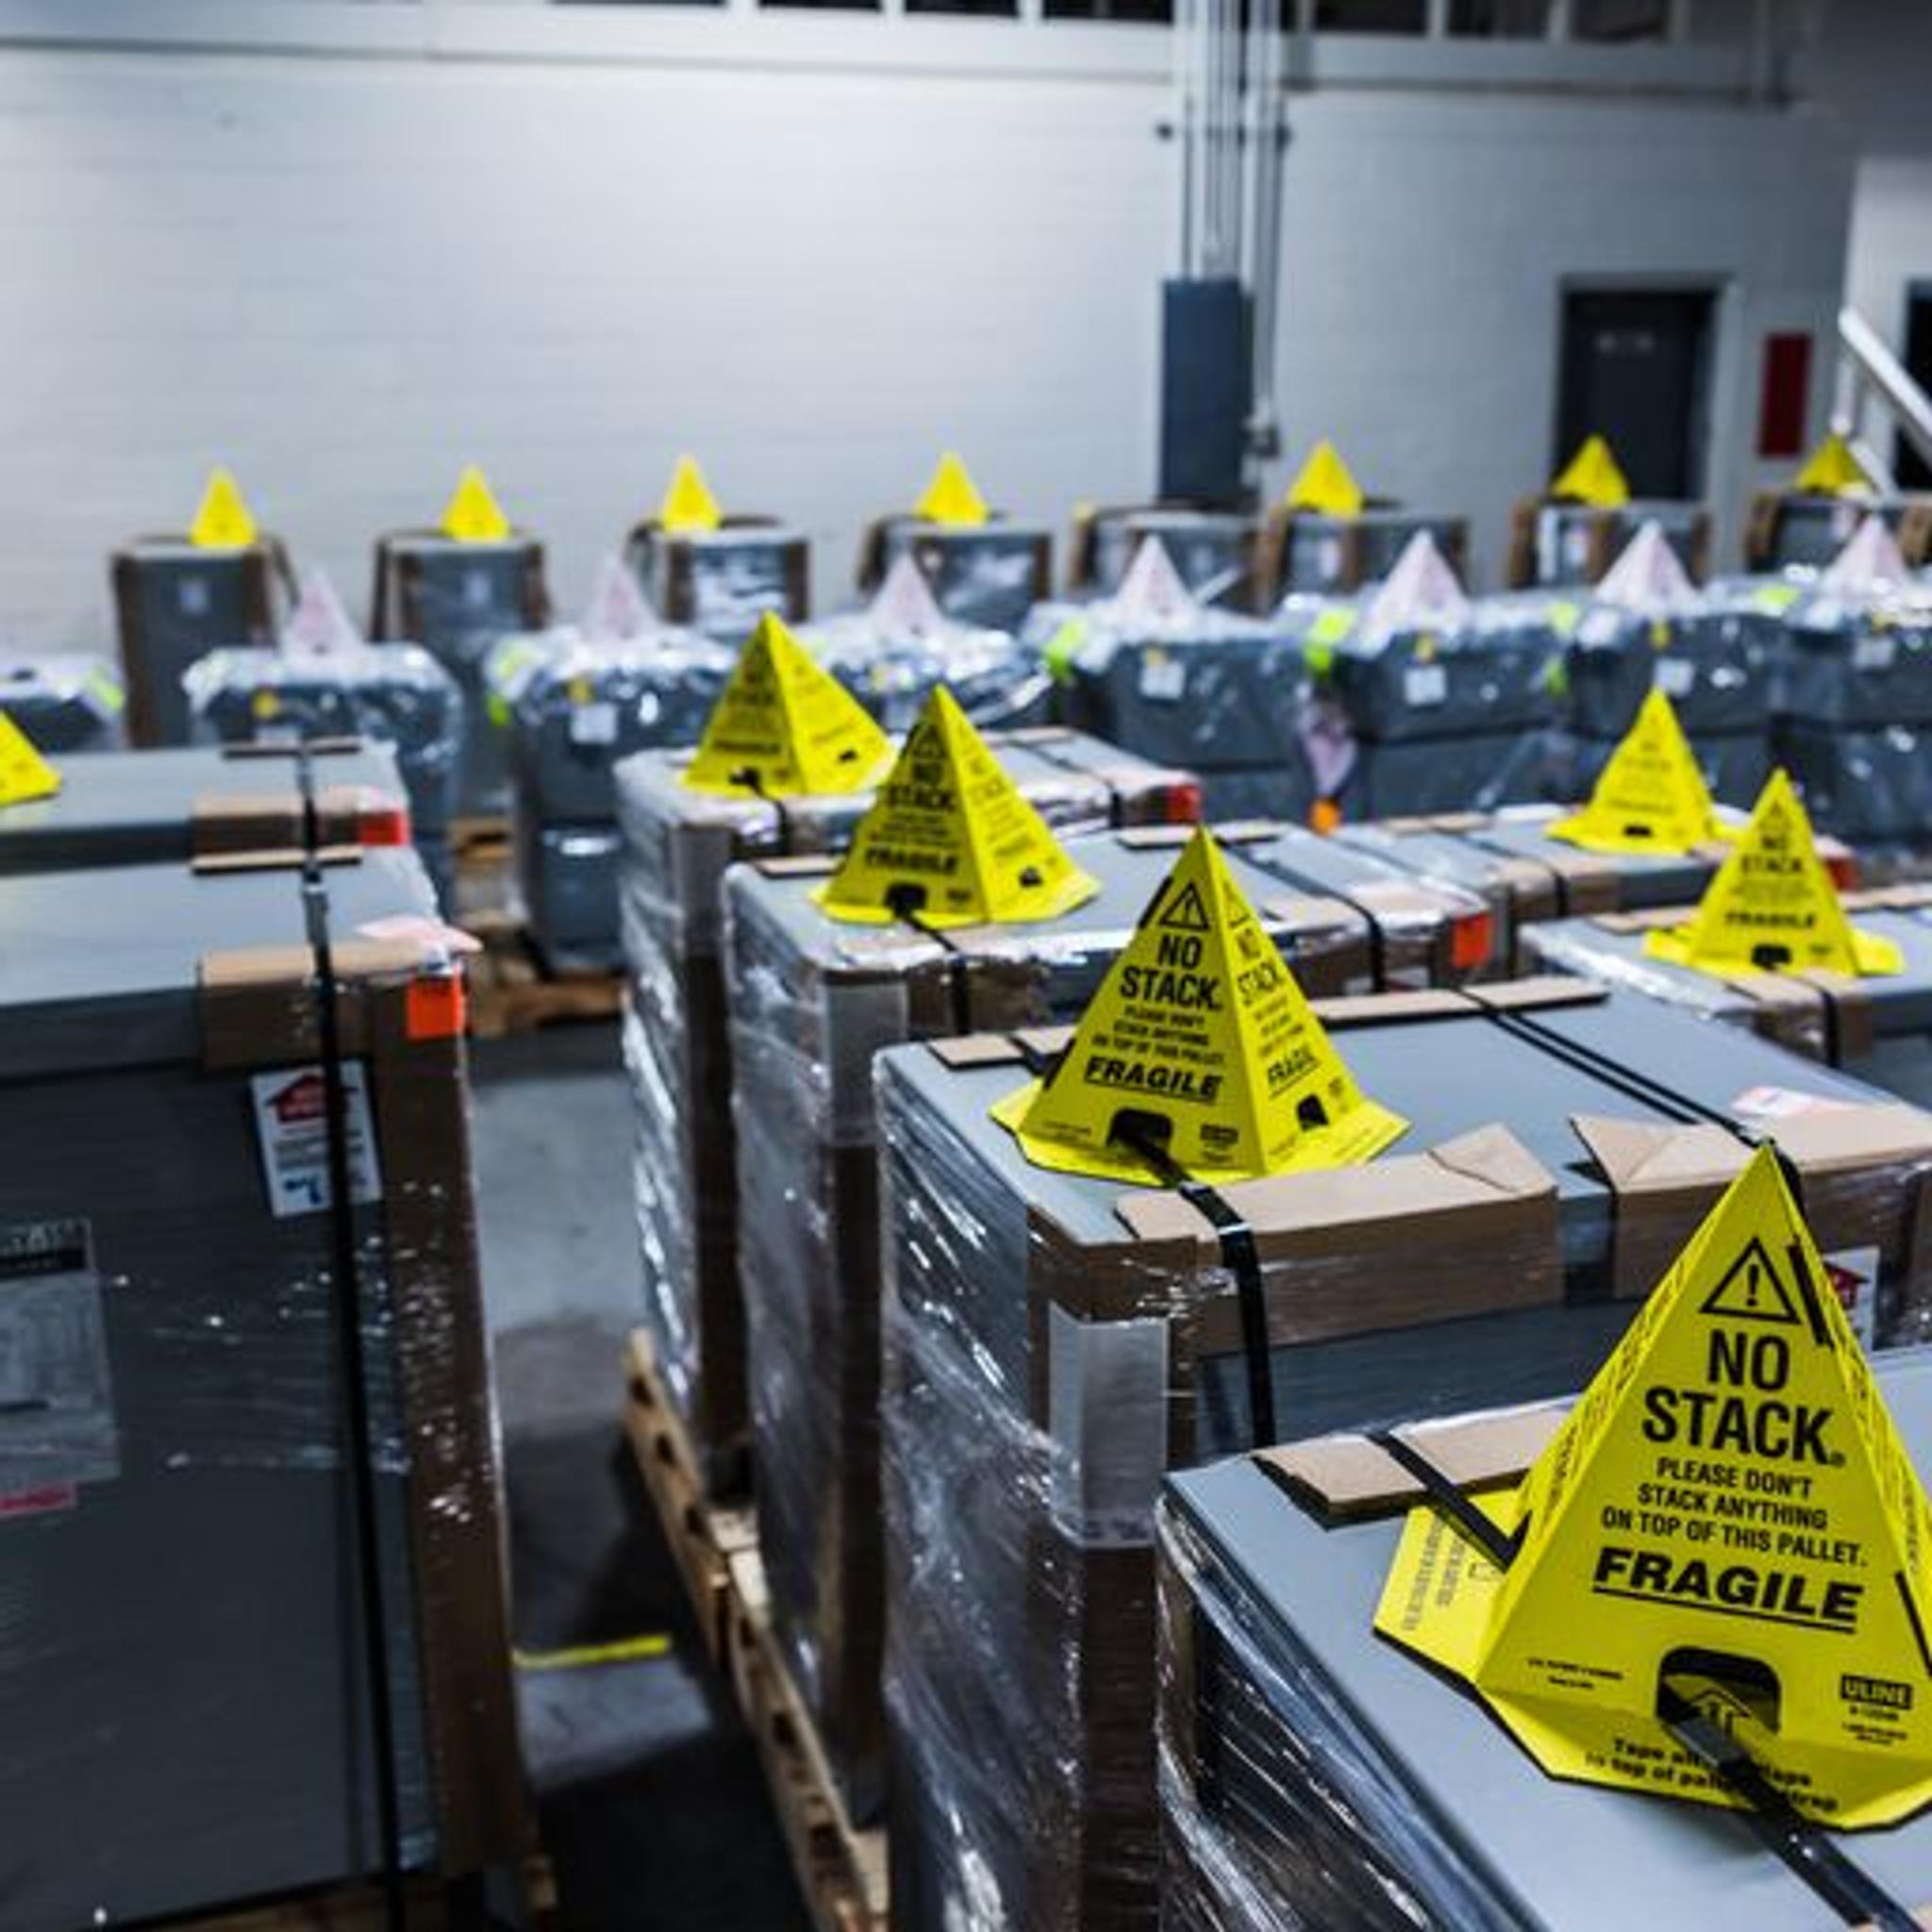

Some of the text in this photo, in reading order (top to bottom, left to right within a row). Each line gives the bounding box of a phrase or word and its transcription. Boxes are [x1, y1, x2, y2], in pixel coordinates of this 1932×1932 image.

[1158, 934, 1203, 970] NO
[1120, 966, 1221, 1011] STACK
[1085, 1056, 1224, 1102] FRAGILE
[1707, 1328, 1790, 1392] NO
[1656, 1457, 1813, 1500] PLEASE DON'T
[1637, 1482, 1828, 1530] STACK ANYTHING
[1600, 1506, 1868, 1568] ON TOP OF THIS PALLET.
[1592, 1546, 1864, 1624] FRAGILE
[1843, 1677, 1908, 1707] ULINE
[1614, 1738, 1665, 1761] Tape
